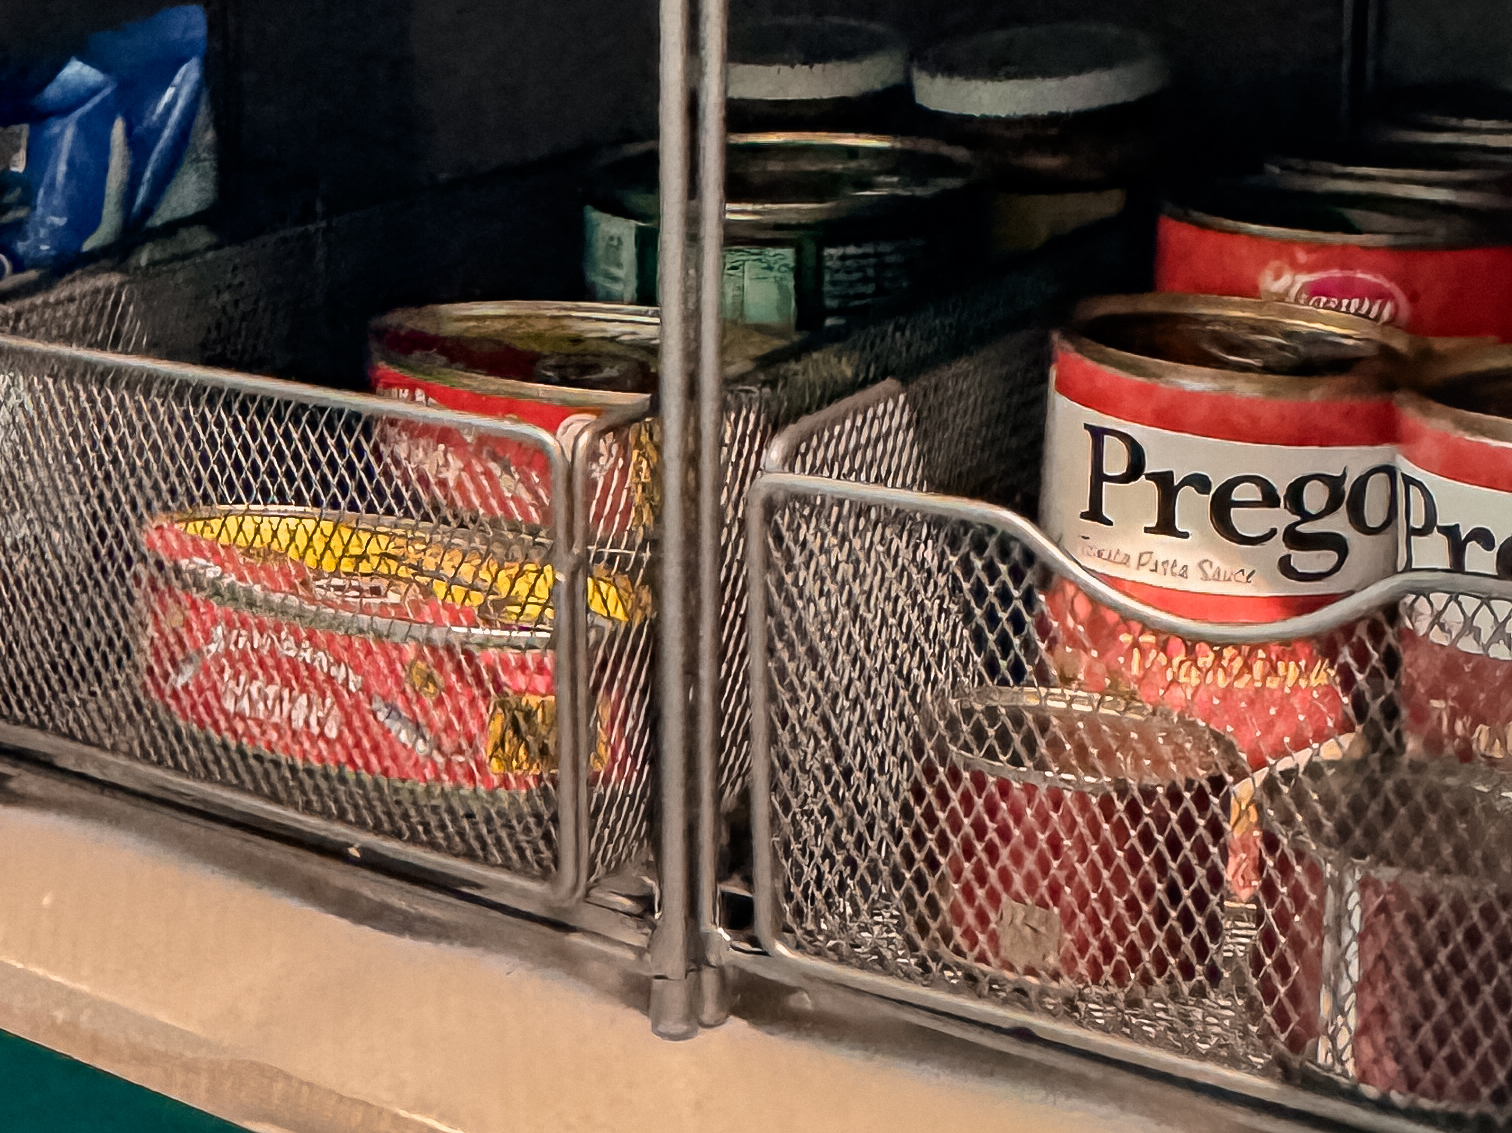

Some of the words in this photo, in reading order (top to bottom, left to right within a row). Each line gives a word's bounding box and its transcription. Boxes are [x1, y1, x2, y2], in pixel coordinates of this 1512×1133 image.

[1079, 422, 1397, 581] Prego
[1136, 550, 1189, 580] Pasta
[1197, 558, 1256, 585] Sauce
